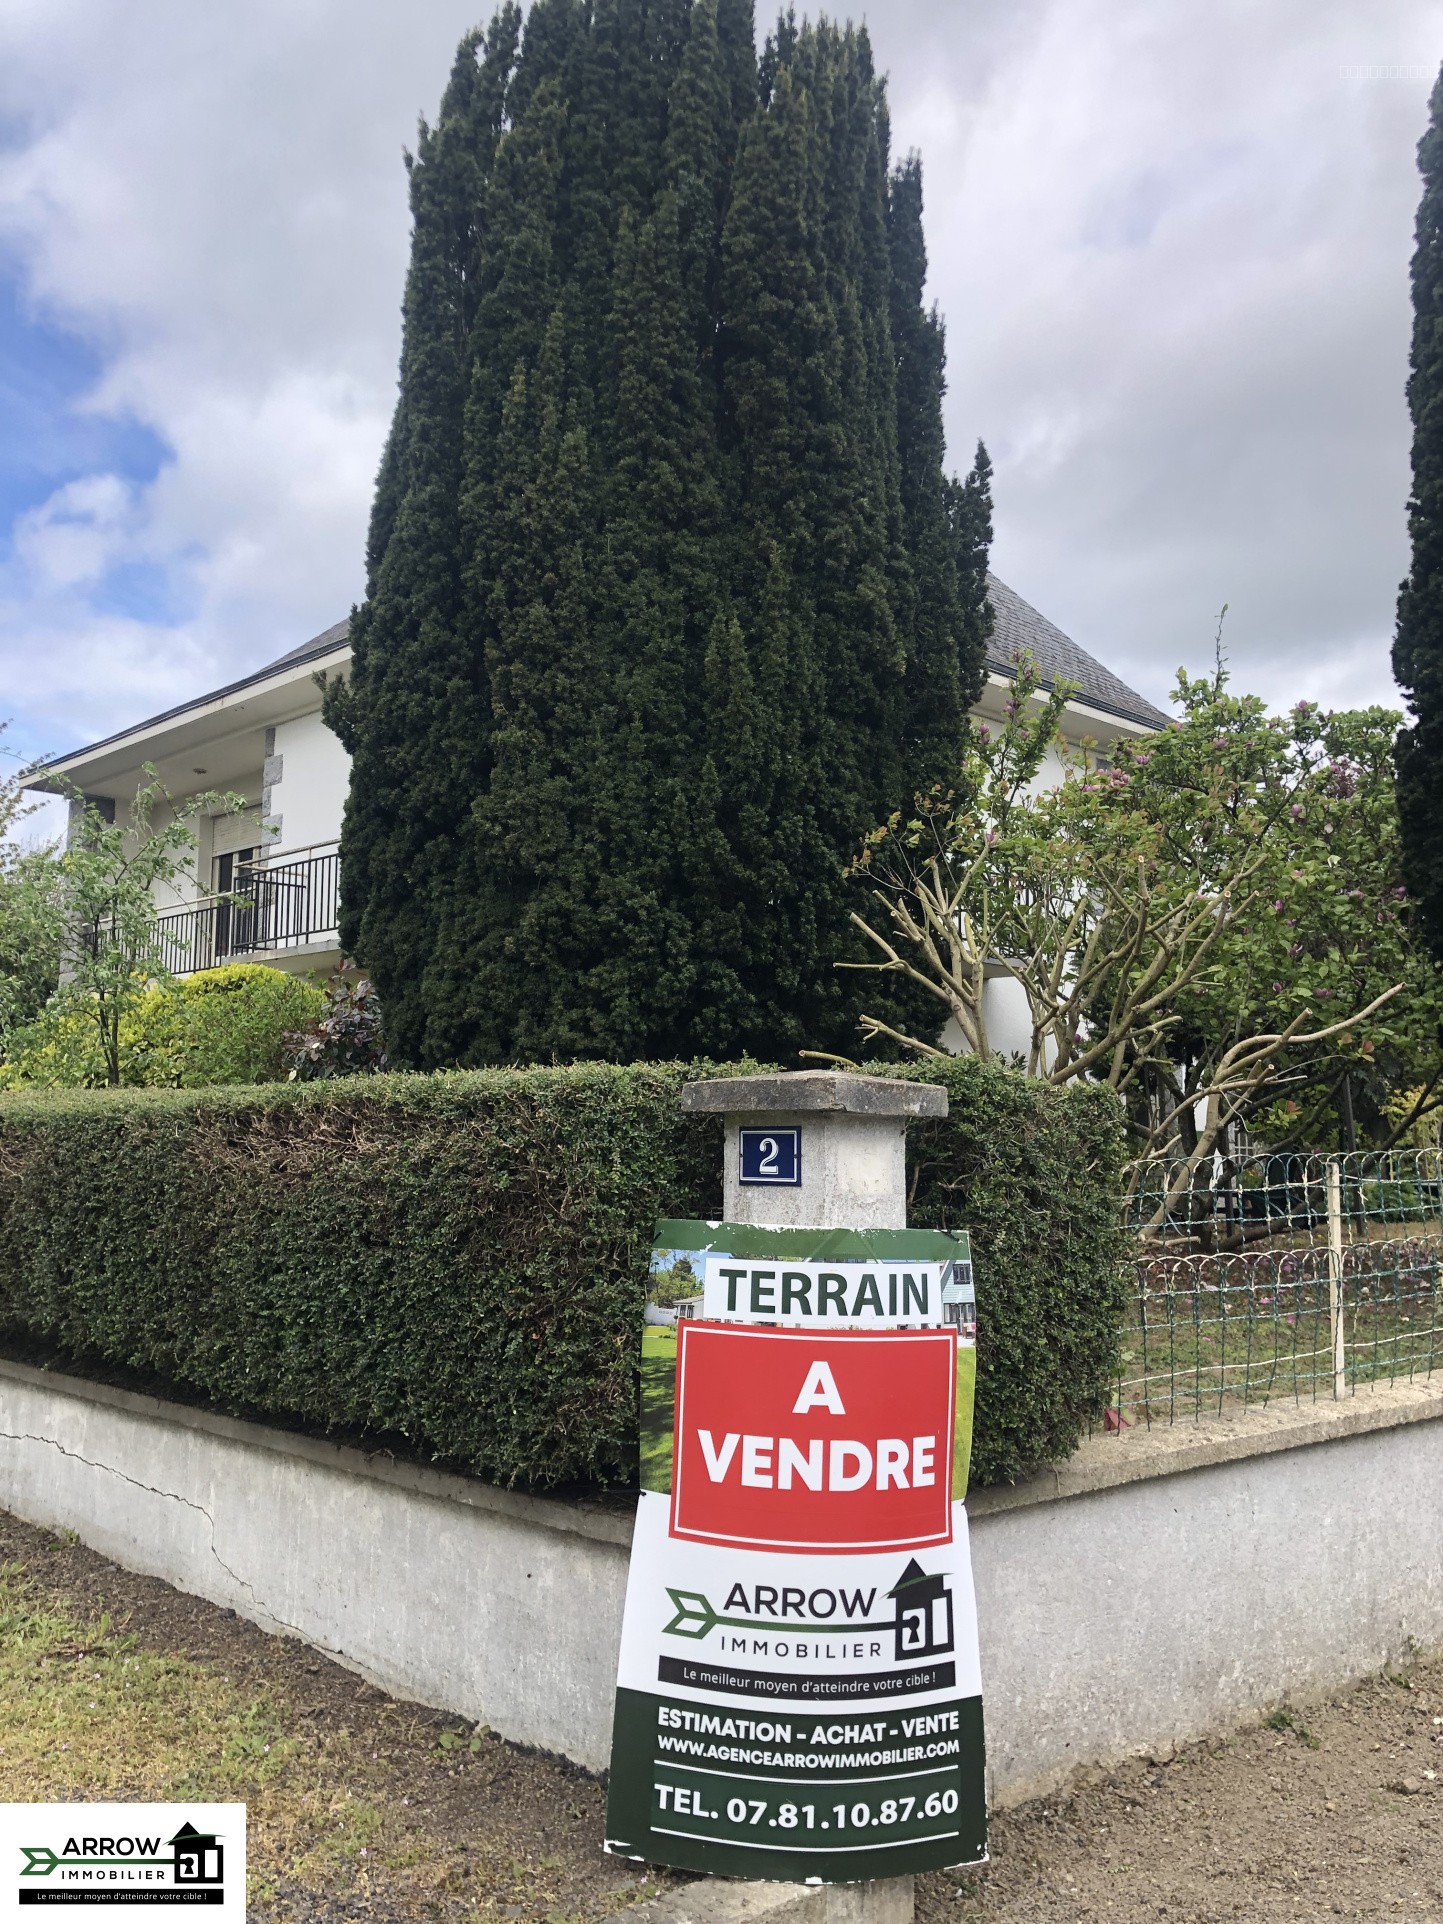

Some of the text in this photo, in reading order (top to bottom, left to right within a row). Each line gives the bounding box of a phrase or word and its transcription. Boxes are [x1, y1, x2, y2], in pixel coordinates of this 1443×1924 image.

[758, 1137, 780, 1175] 2
[719, 1268, 929, 1317] TERRAIN
[792, 1360, 846, 1416] A
[697, 1429, 936, 1492] VENDRE
[723, 1582, 877, 1618] ARROW
[721, 1636, 882, 1659] IMMOBILIER
[683, 1666, 697, 1681] Le
[700, 1671, 750, 1689] meilleur
[754, 1679, 798, 1694] moyen
[873, 1678, 903, 1691] votre
[906, 1673, 930, 1686] cible
[657, 1706, 792, 1744] ESTIMATION
[810, 1722, 887, 1745] ACHAT
[902, 1711, 960, 1737] VENTE
[657, 1735, 960, 1769] WWW.AGENCEARROWIMMOBILIER.COM
[654, 1783, 959, 1830] TEL. 07.81.10.87.60
